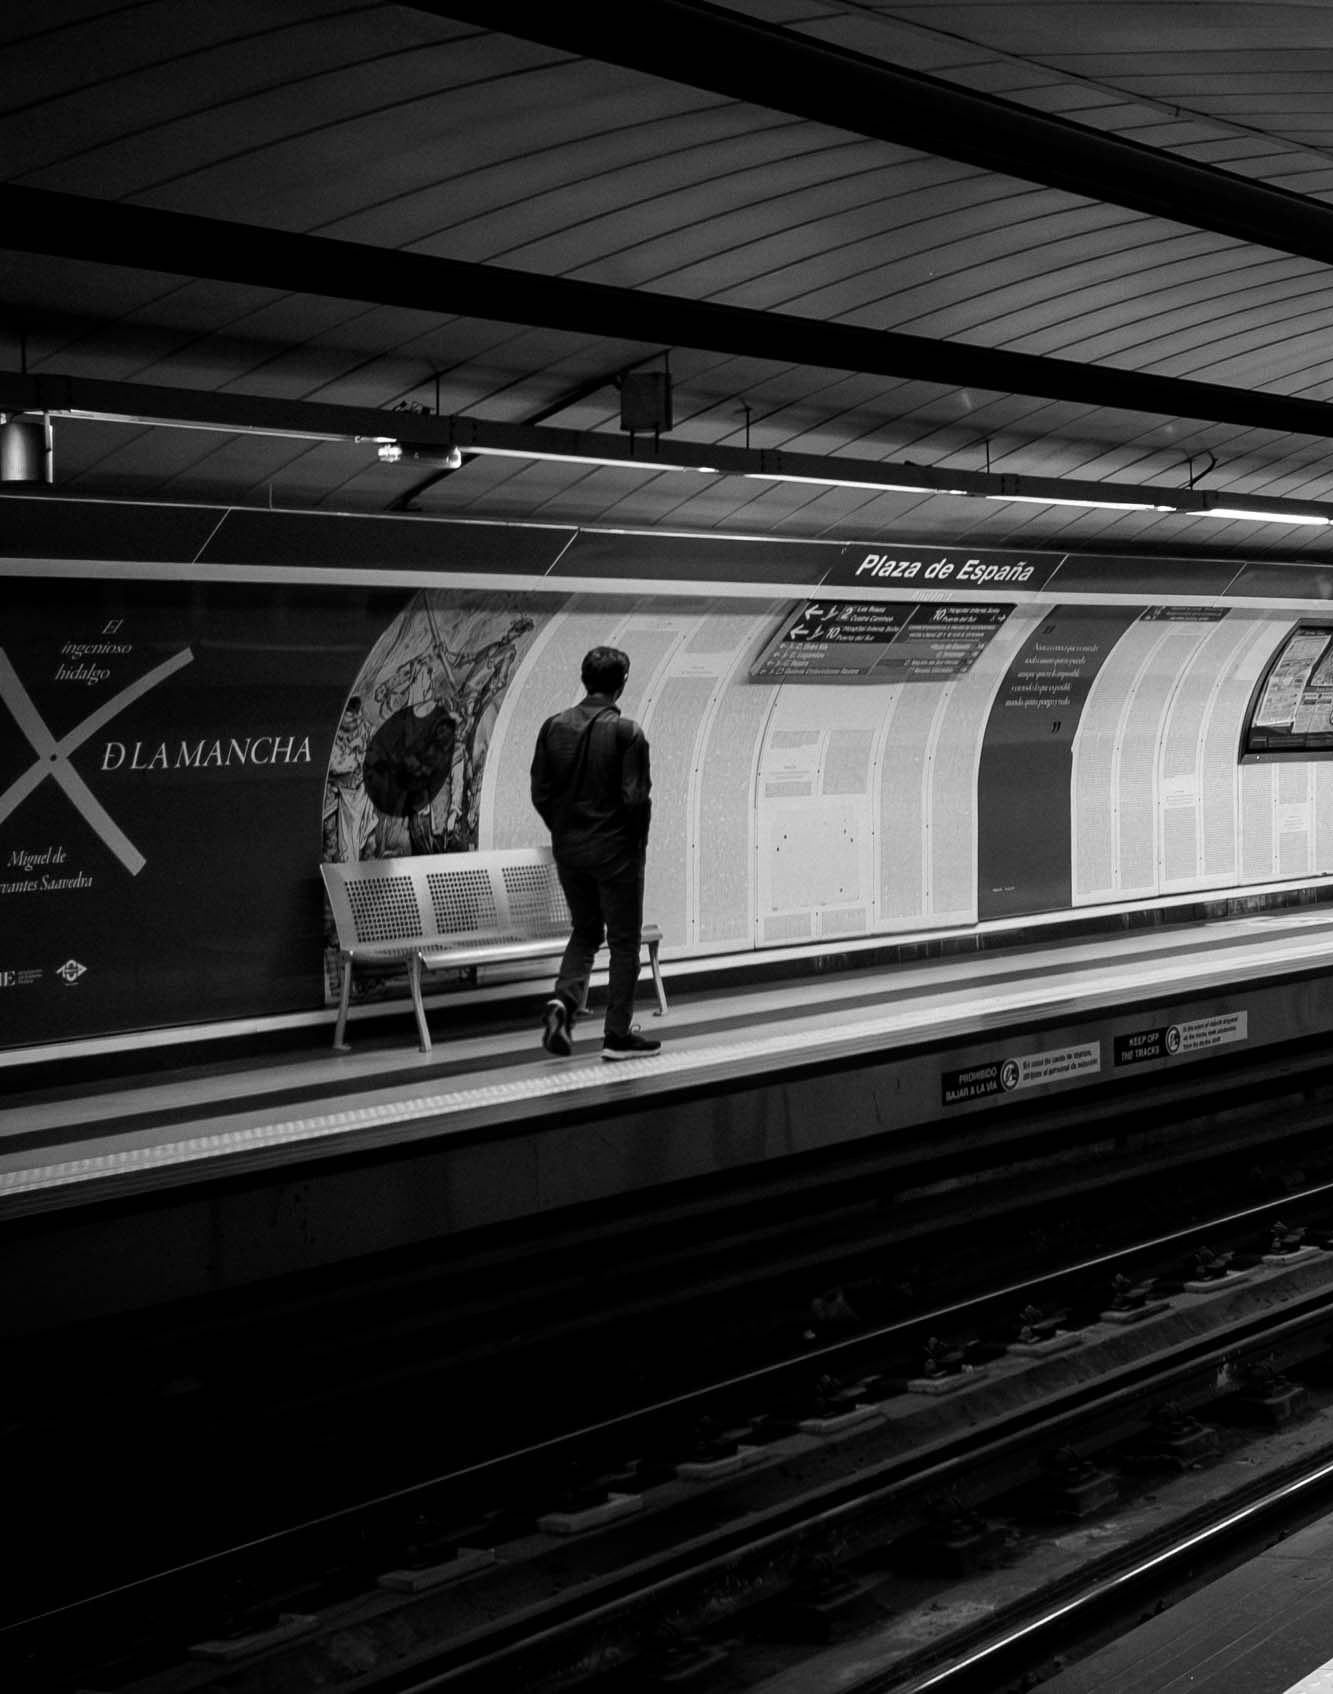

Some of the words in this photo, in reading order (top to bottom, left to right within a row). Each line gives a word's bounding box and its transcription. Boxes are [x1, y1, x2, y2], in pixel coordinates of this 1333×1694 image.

[856, 554, 922, 578] Plaza
[924, 558, 954, 579] de
[956, 559, 1035, 584] España
[101, 619, 124, 635] El
[61, 640, 133, 660] ingenioso
[54, 662, 111, 685] hidalgo
[128, 740, 169, 770] LA
[174, 736, 312, 769] MANCHA
[7, 846, 53, 871] Miguel
[52, 845, 67, 864] de
[40, 871, 93, 891] Saavedra
